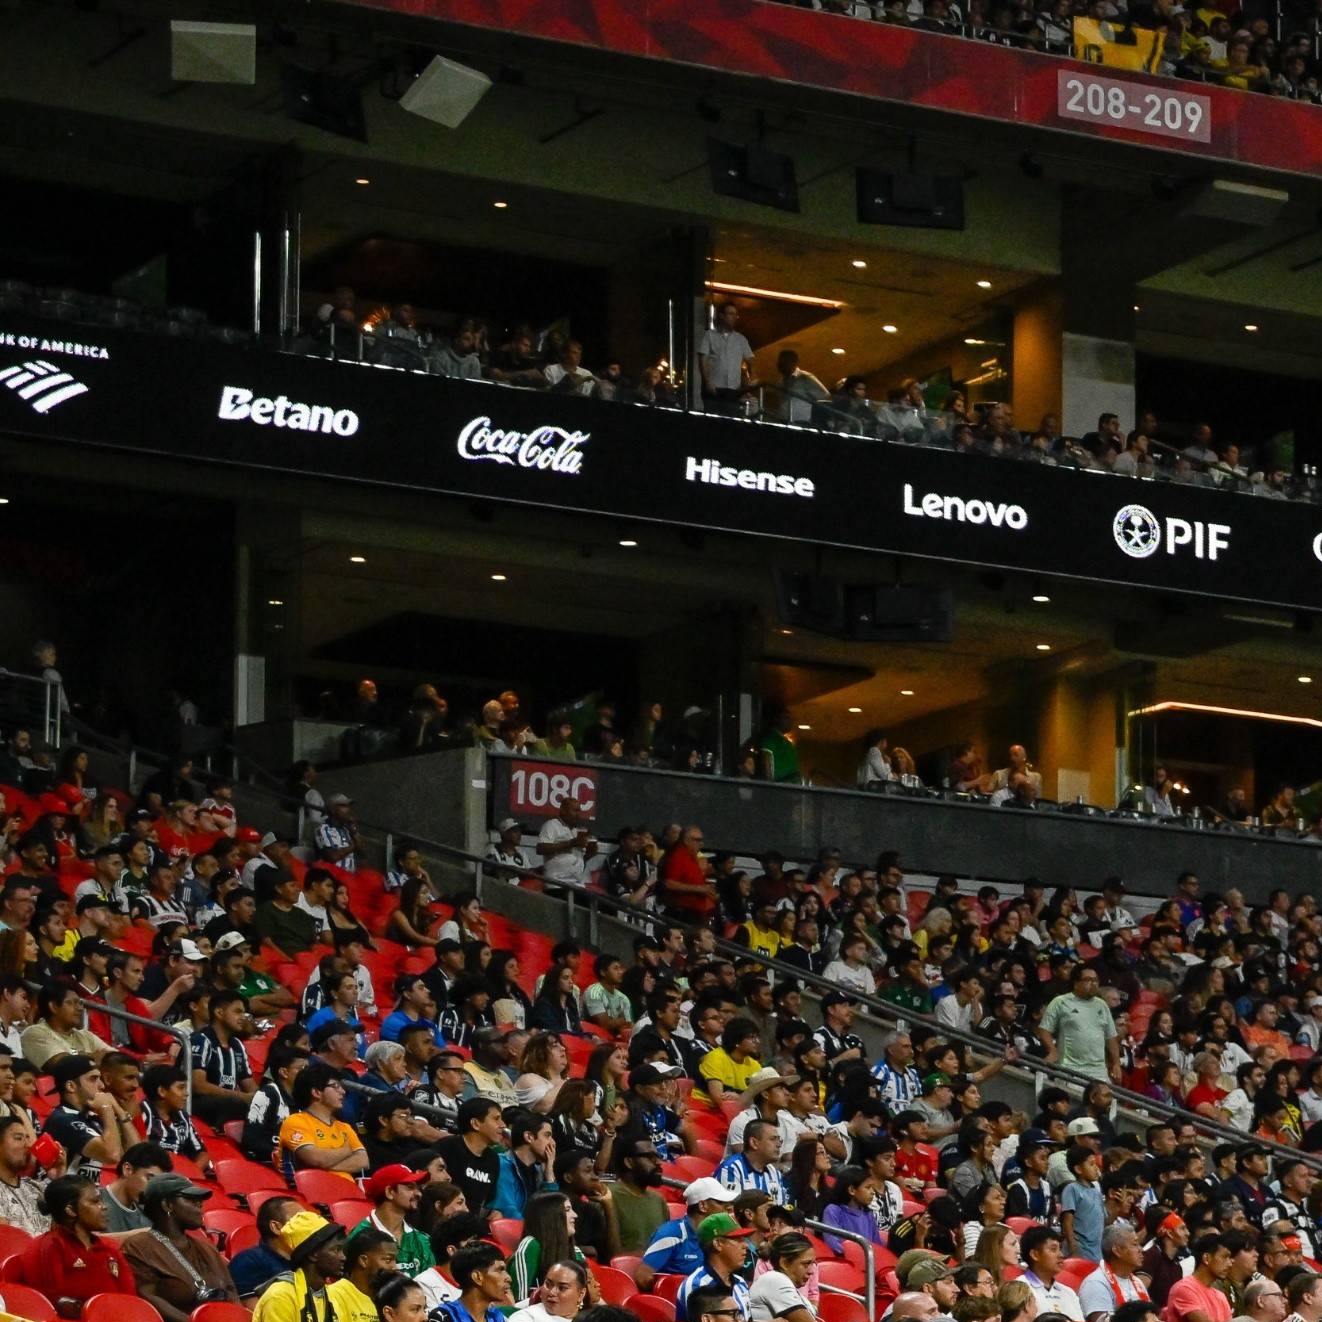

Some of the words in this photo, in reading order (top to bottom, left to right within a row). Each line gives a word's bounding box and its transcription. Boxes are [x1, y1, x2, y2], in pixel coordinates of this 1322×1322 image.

[1066, 79, 1203, 134] 208-209
[18, 336, 39, 350] OF
[41, 339, 109, 361] AMERICA
[218, 385, 359, 437] Betano
[685, 456, 815, 498] Hisense
[903, 483, 1028, 530] Lenovo
[1165, 516, 1232, 561] PIF
[512, 769, 596, 811] 108C
